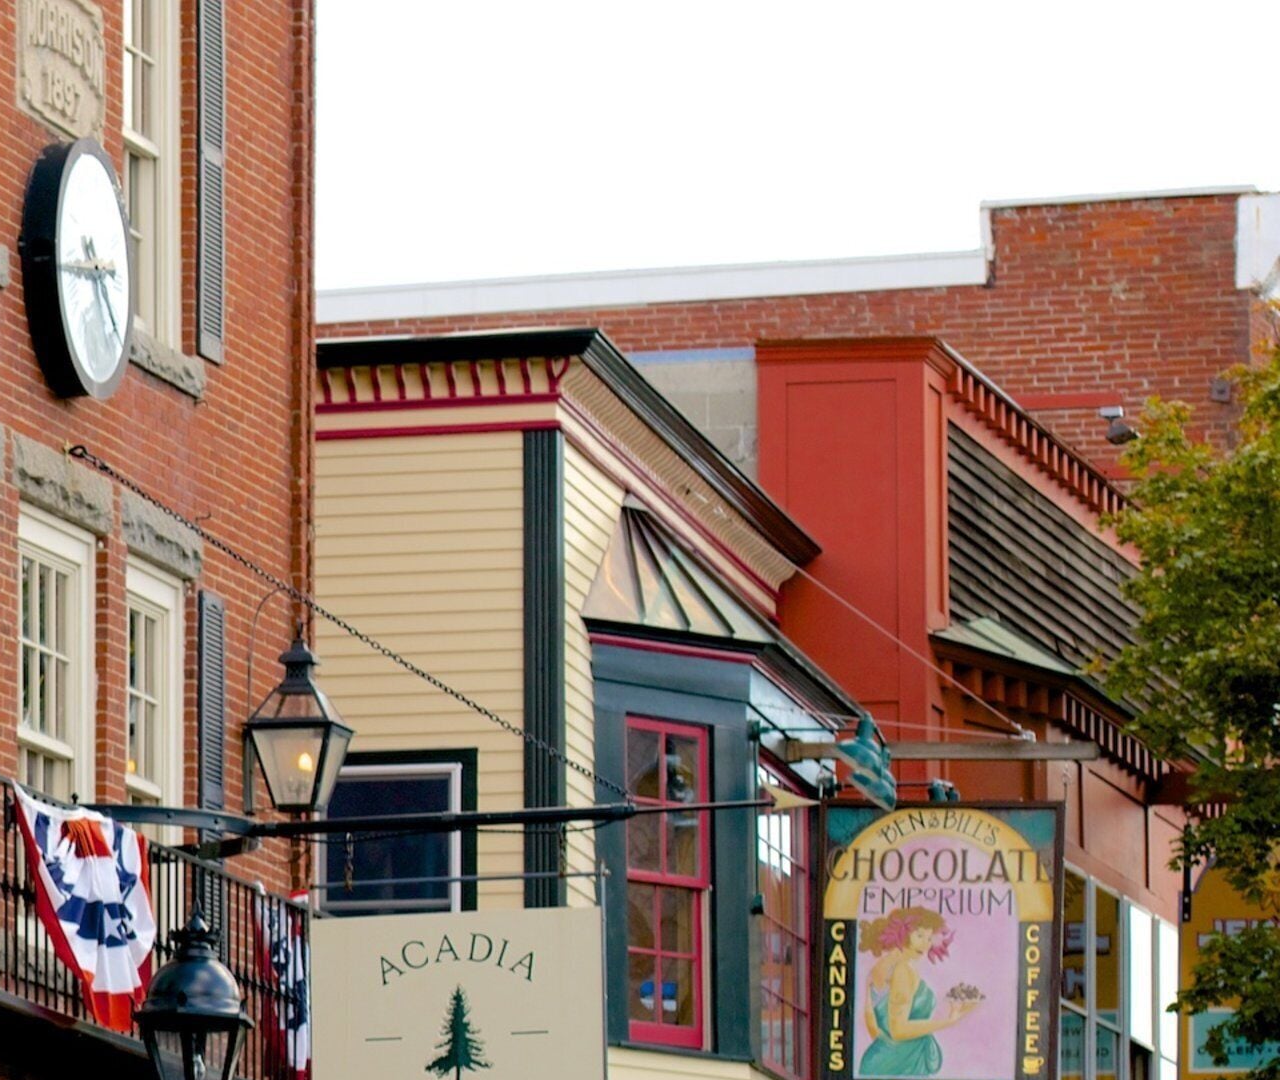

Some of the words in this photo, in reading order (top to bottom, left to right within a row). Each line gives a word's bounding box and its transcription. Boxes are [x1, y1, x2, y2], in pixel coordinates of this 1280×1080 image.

[27, 0, 104, 97] MORRISON
[879, 811, 928, 846] BEN
[943, 809, 1000, 846] BILL'S
[827, 848, 1054, 884] CHOCOLATE
[862, 886, 1015, 916] EMPORIUM
[379, 932, 535, 986] ACADIA
[828, 921, 848, 1072] CANDIES
[1024, 924, 1042, 1055] COFFEE
